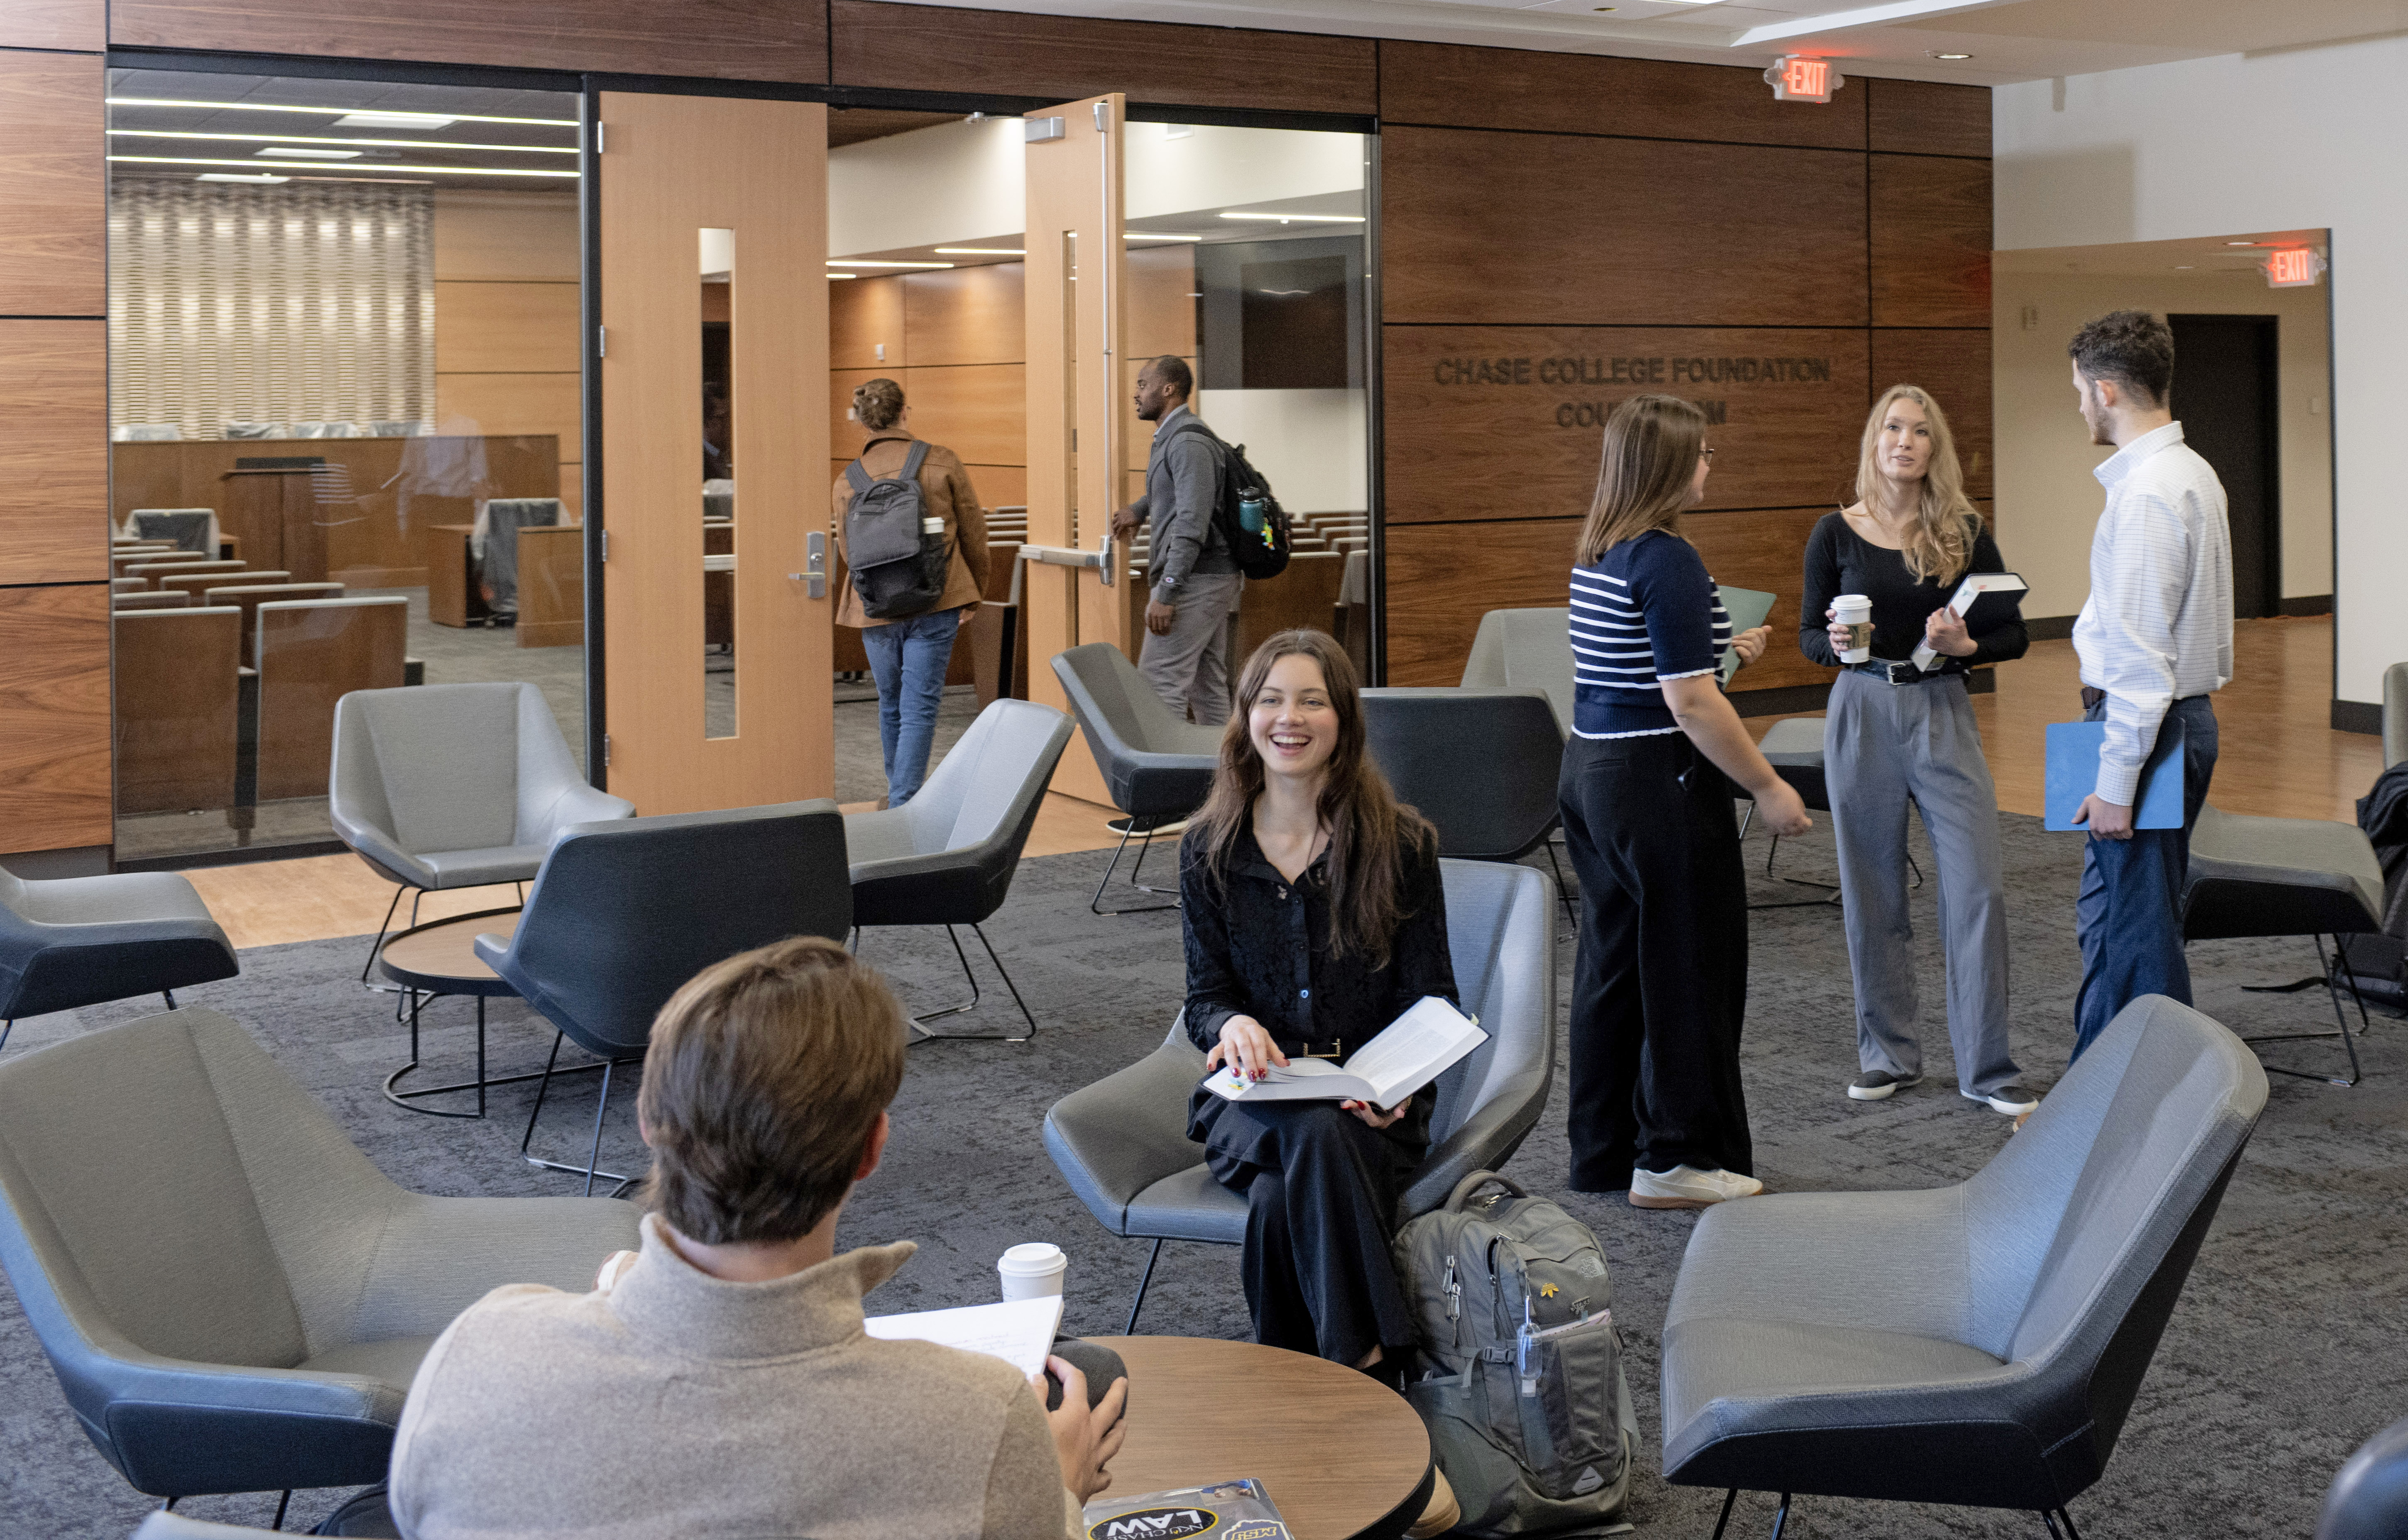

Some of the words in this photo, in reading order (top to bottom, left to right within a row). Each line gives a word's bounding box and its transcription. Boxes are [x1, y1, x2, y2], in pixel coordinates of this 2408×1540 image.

[1789, 61, 1828, 95] EXIT
[2272, 249, 2309, 283] EXIT
[1434, 358, 1530, 384] CHASE
[1539, 357, 1664, 384] COLLEGE
[1672, 357, 1830, 383] FOUNDATION
[1107, 1510, 1202, 1537] LAW
[1170, 1523, 1204, 1535] NKU
[1231, 1527, 1277, 1540] MSJ
